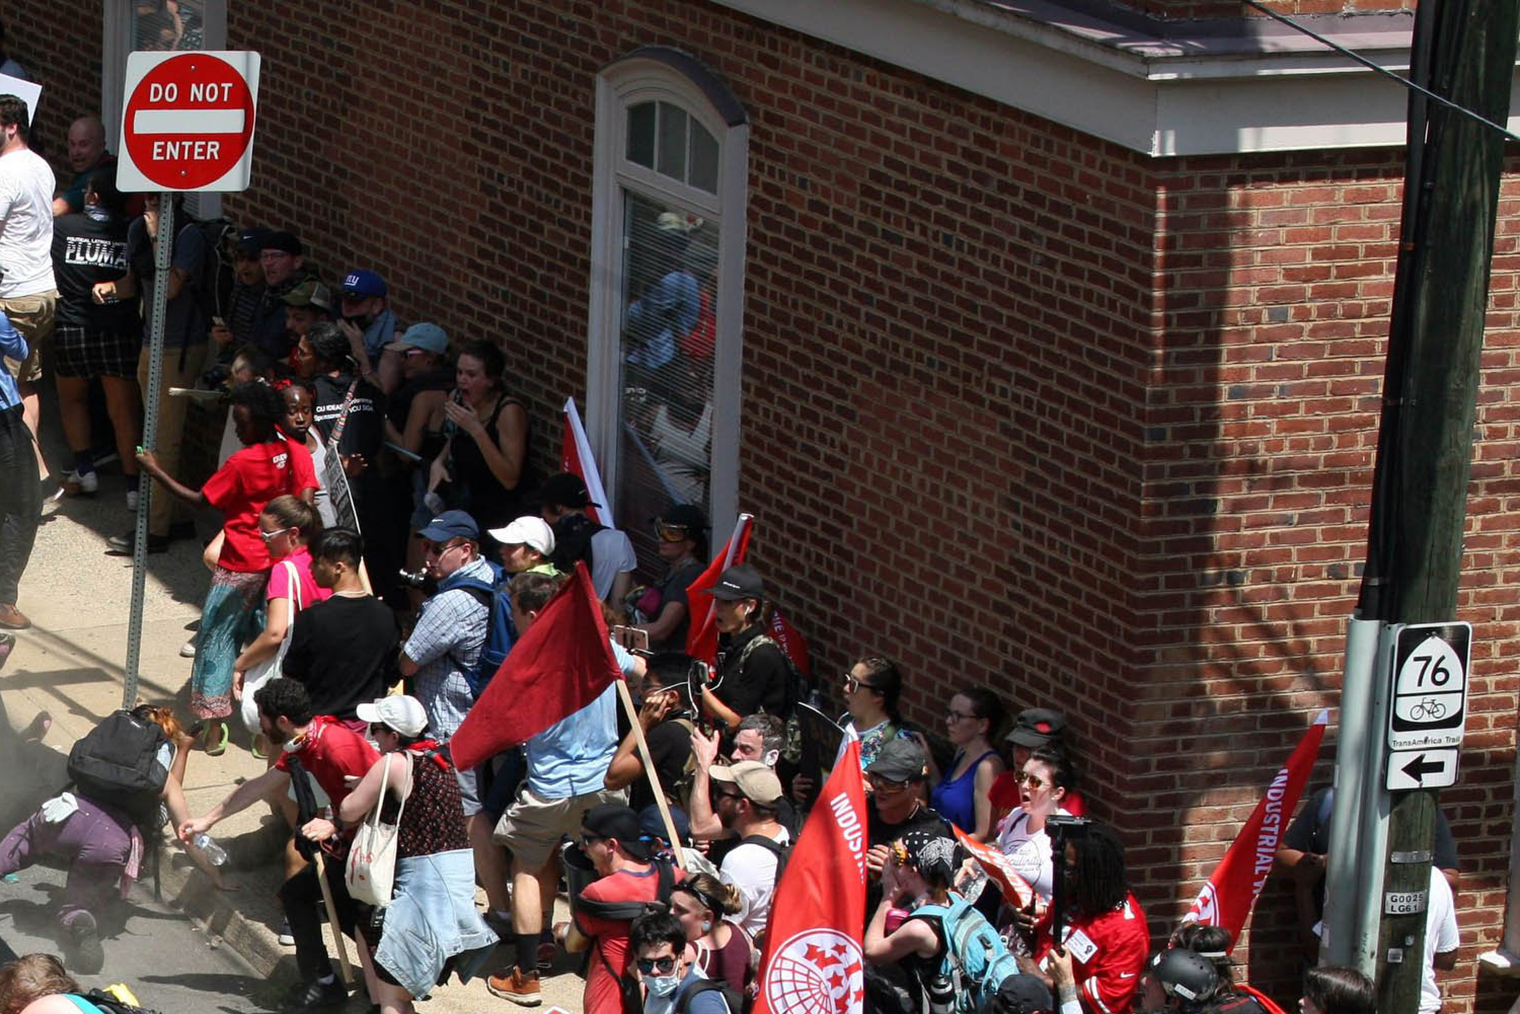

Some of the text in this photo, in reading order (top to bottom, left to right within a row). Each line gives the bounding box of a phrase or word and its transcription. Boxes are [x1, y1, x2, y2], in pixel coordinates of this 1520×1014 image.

[149, 83, 233, 102] DO NOT
[153, 141, 220, 160] ENTER
[1413, 655, 1450, 687] 76
[1252, 768, 1289, 876] INDUSTRIAL
